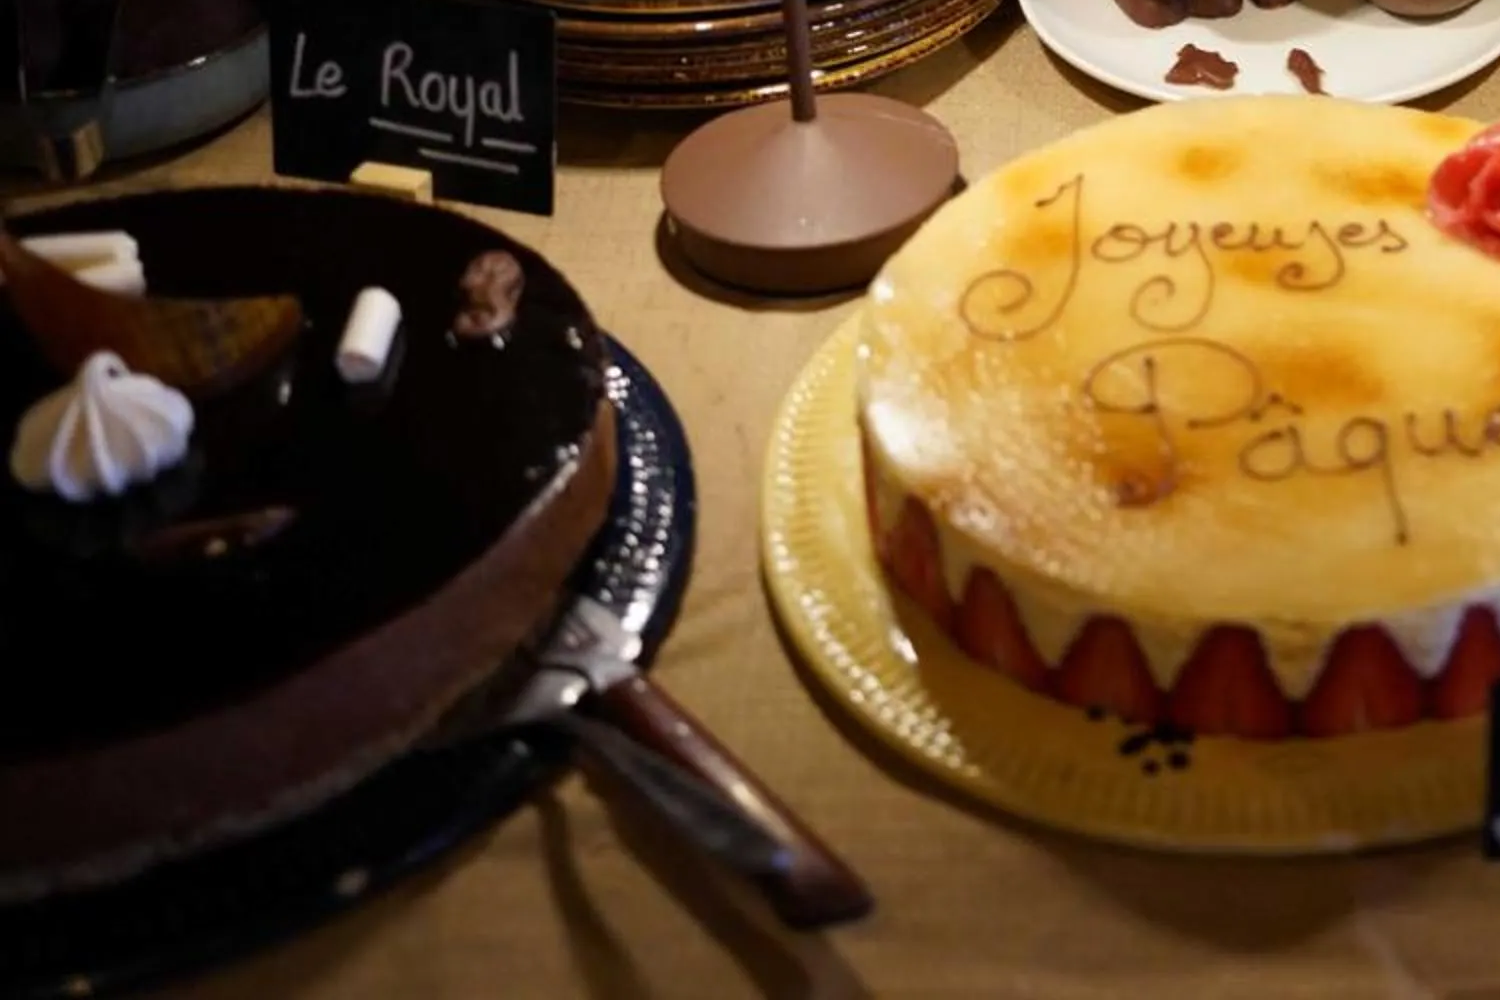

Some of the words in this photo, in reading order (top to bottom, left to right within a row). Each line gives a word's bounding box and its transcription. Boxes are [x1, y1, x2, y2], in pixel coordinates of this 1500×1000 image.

[289, 32, 349, 98] Le
[379, 40, 525, 148] Royal
[958, 173, 1409, 342] Joyeuses
